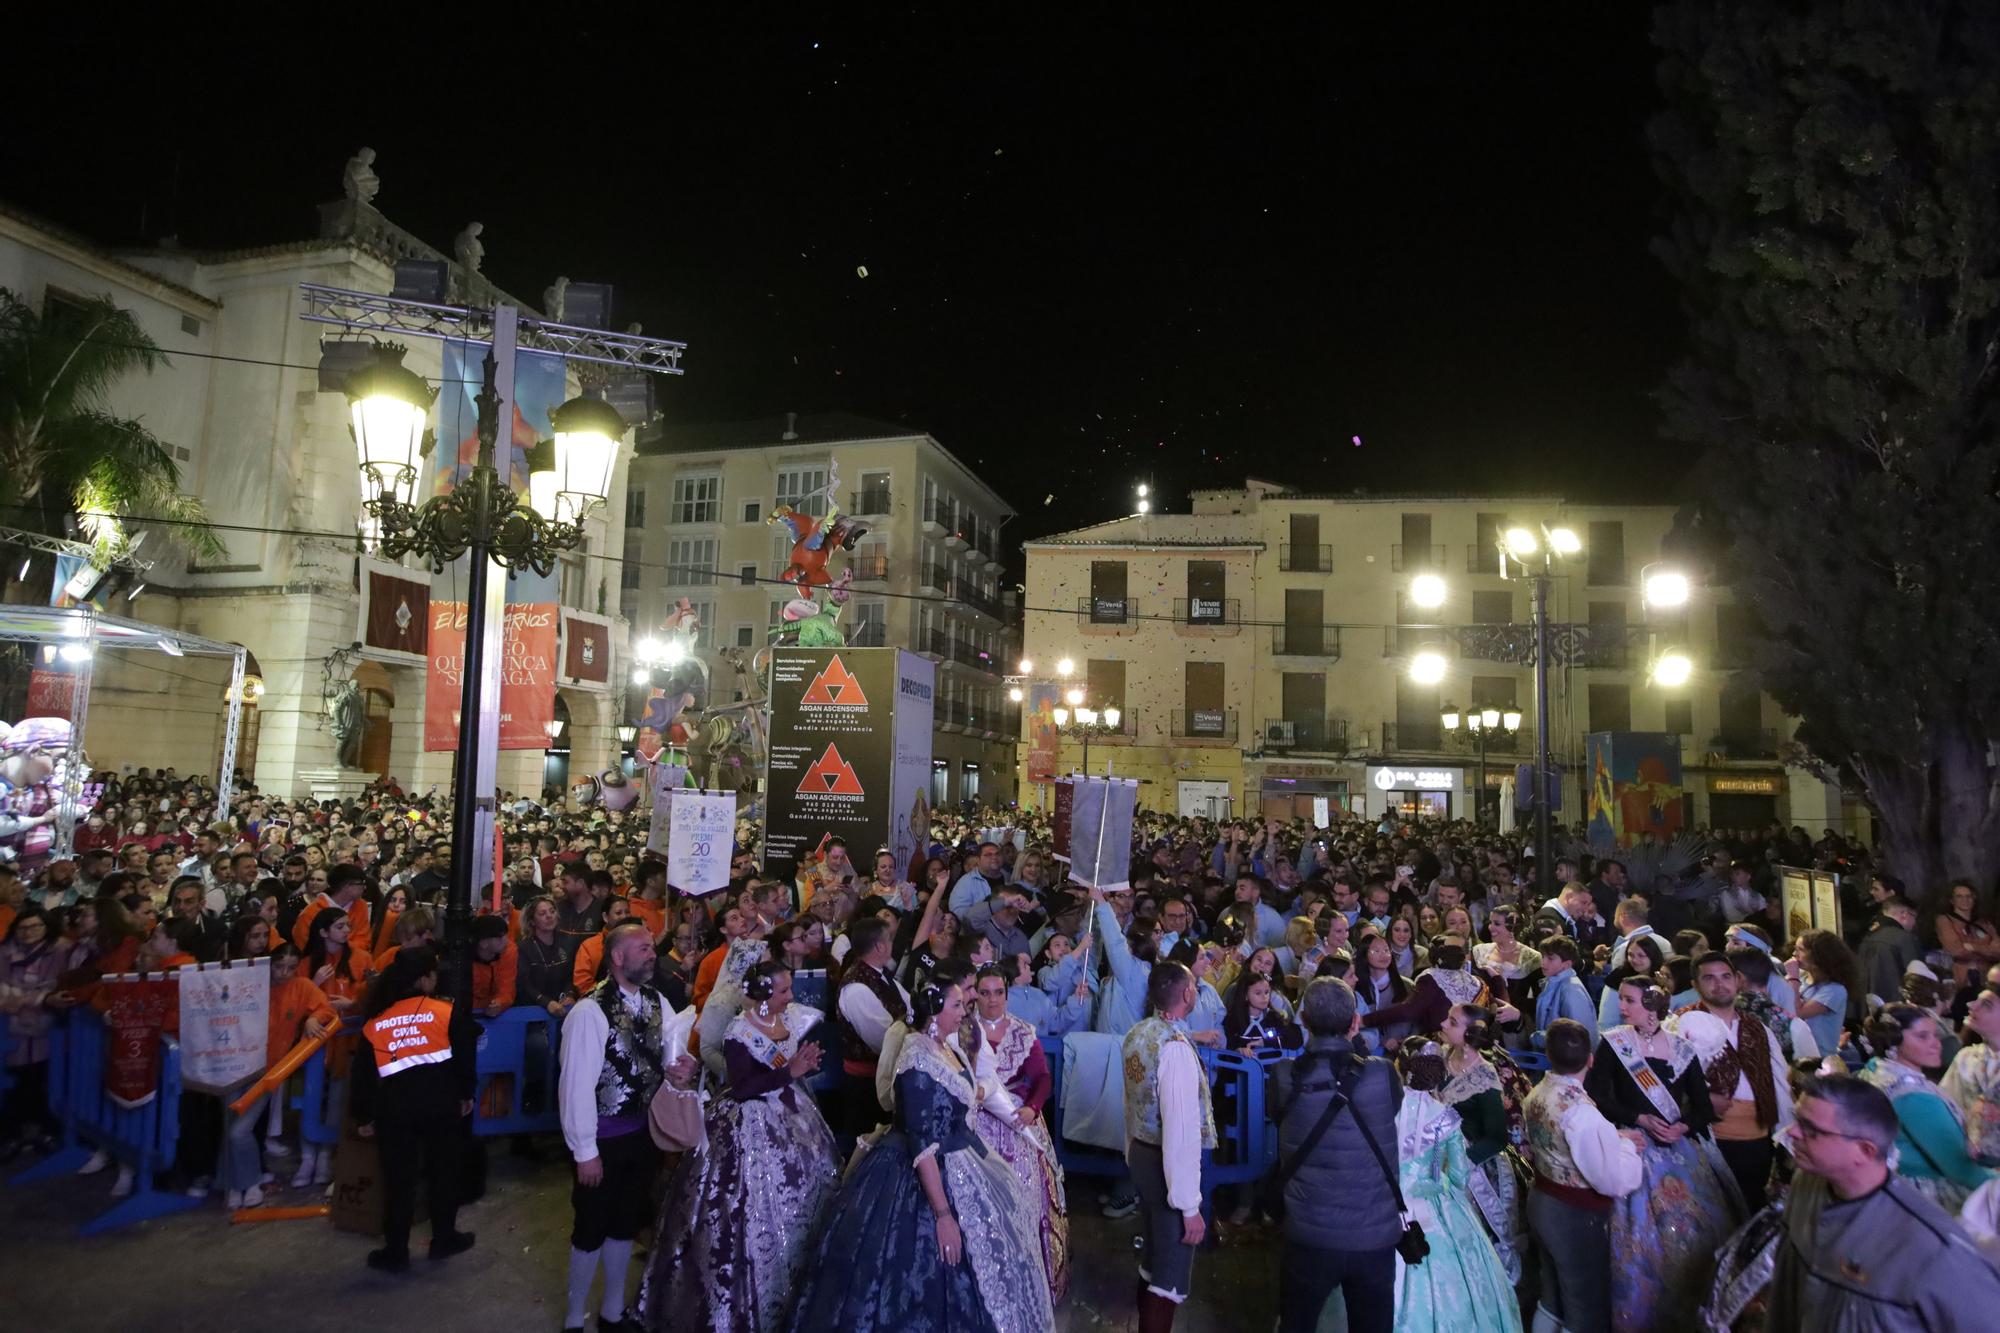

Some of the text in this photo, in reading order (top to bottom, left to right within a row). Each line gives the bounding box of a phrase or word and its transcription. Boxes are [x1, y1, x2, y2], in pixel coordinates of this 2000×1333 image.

[819, 794, 865, 802] ASCENSORES
[1193, 807, 1206, 815] the
[691, 842, 711, 856] 20
[375, 1011, 434, 1032] PROTECCIÓ
[216, 1029, 231, 1046] 4
[392, 1025, 421, 1038] CIVIL
[128, 1040, 141, 1058] 3
[388, 1035, 429, 1052] GANDIA
